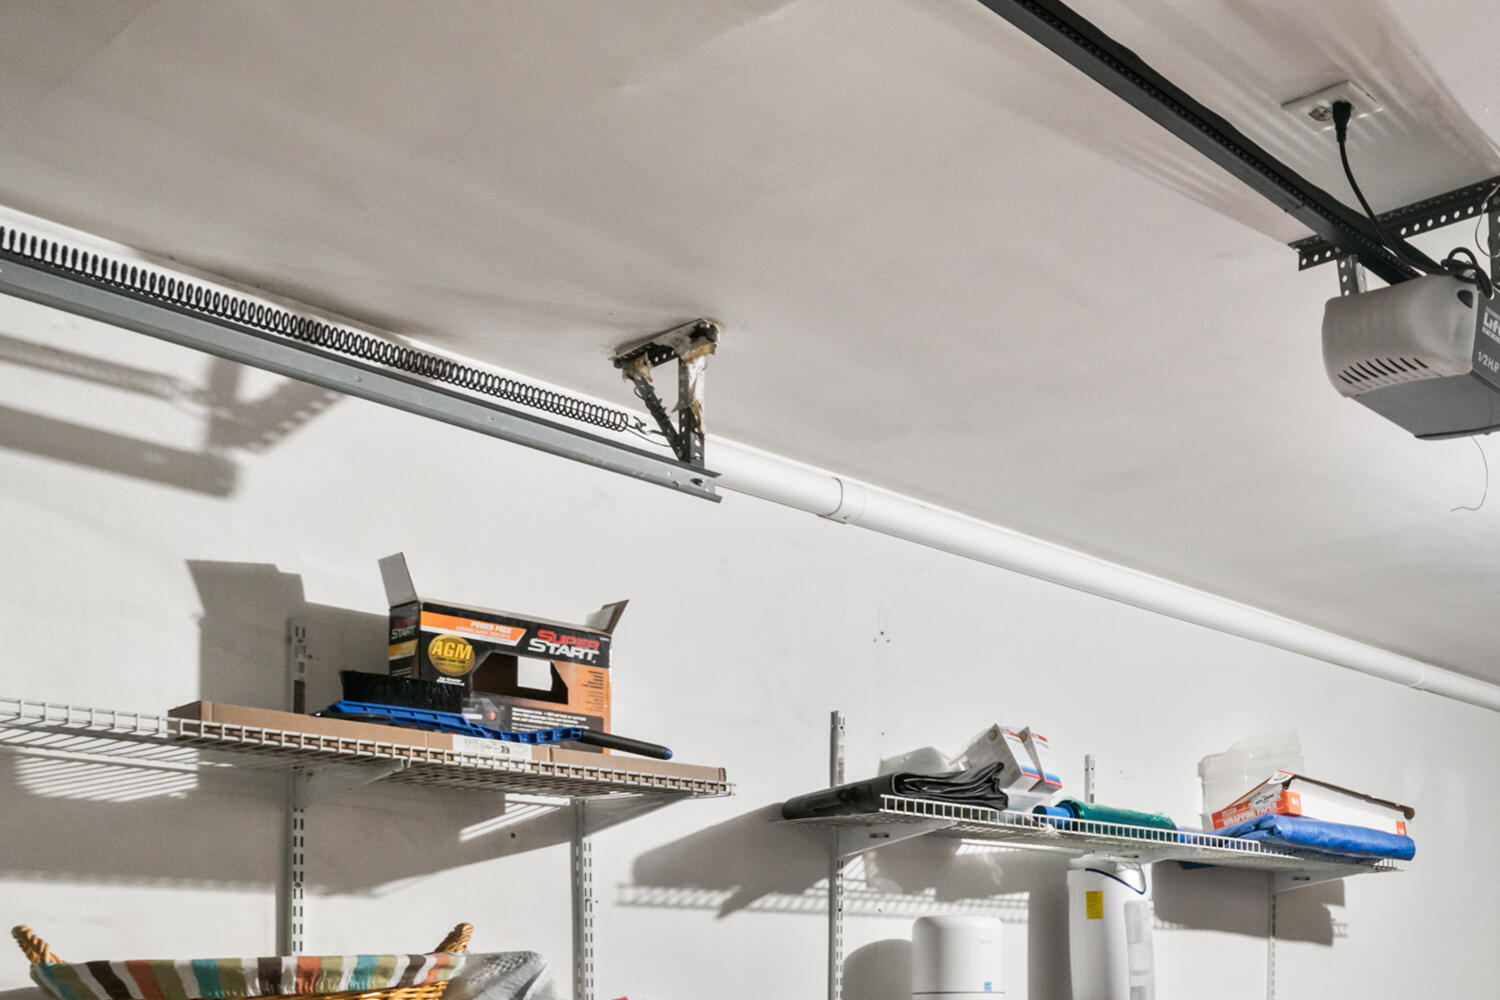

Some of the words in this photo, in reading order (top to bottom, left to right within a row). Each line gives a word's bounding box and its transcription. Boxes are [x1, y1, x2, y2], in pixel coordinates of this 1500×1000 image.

[391, 624, 417, 639] START
[536, 629, 600, 650] SUPER
[431, 640, 473, 660] AGM
[527, 638, 600, 661] START
